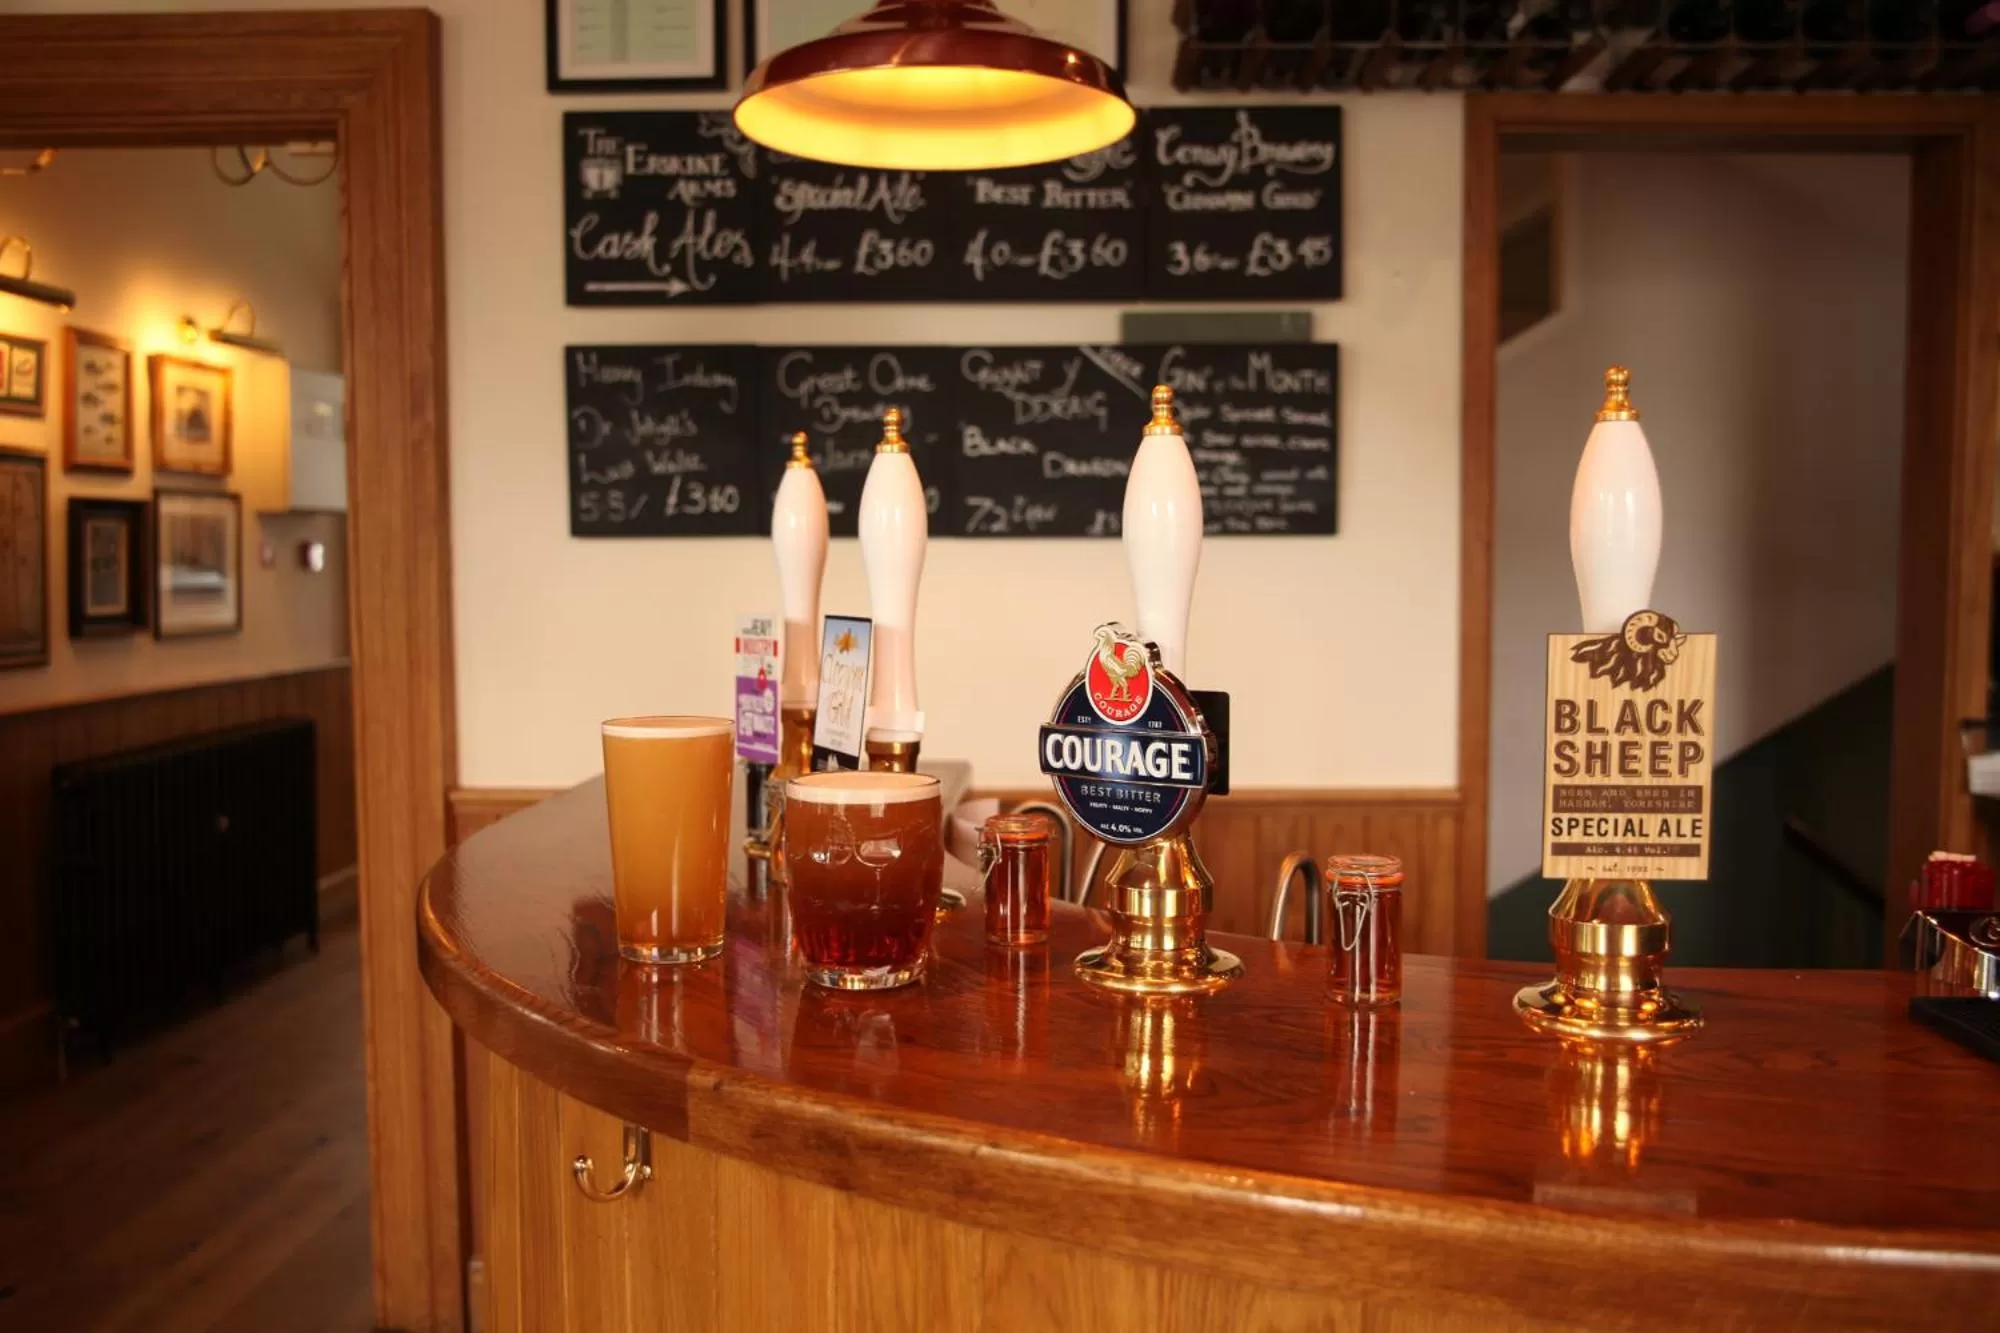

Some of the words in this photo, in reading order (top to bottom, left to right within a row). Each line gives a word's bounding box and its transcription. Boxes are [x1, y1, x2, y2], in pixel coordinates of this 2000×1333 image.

[1094, 692, 1144, 718] COURAGE
[1554, 698, 1705, 737] BLACK
[1046, 733, 1194, 781] COURAGE
[1553, 739, 1705, 778] SHEEP
[1080, 784, 1112, 798] BEST
[1115, 788, 1162, 803] BITTER
[1110, 823, 1132, 834] 4.0%
[1551, 817, 1650, 837] SPECIAL
[1657, 817, 1704, 838] ALE
